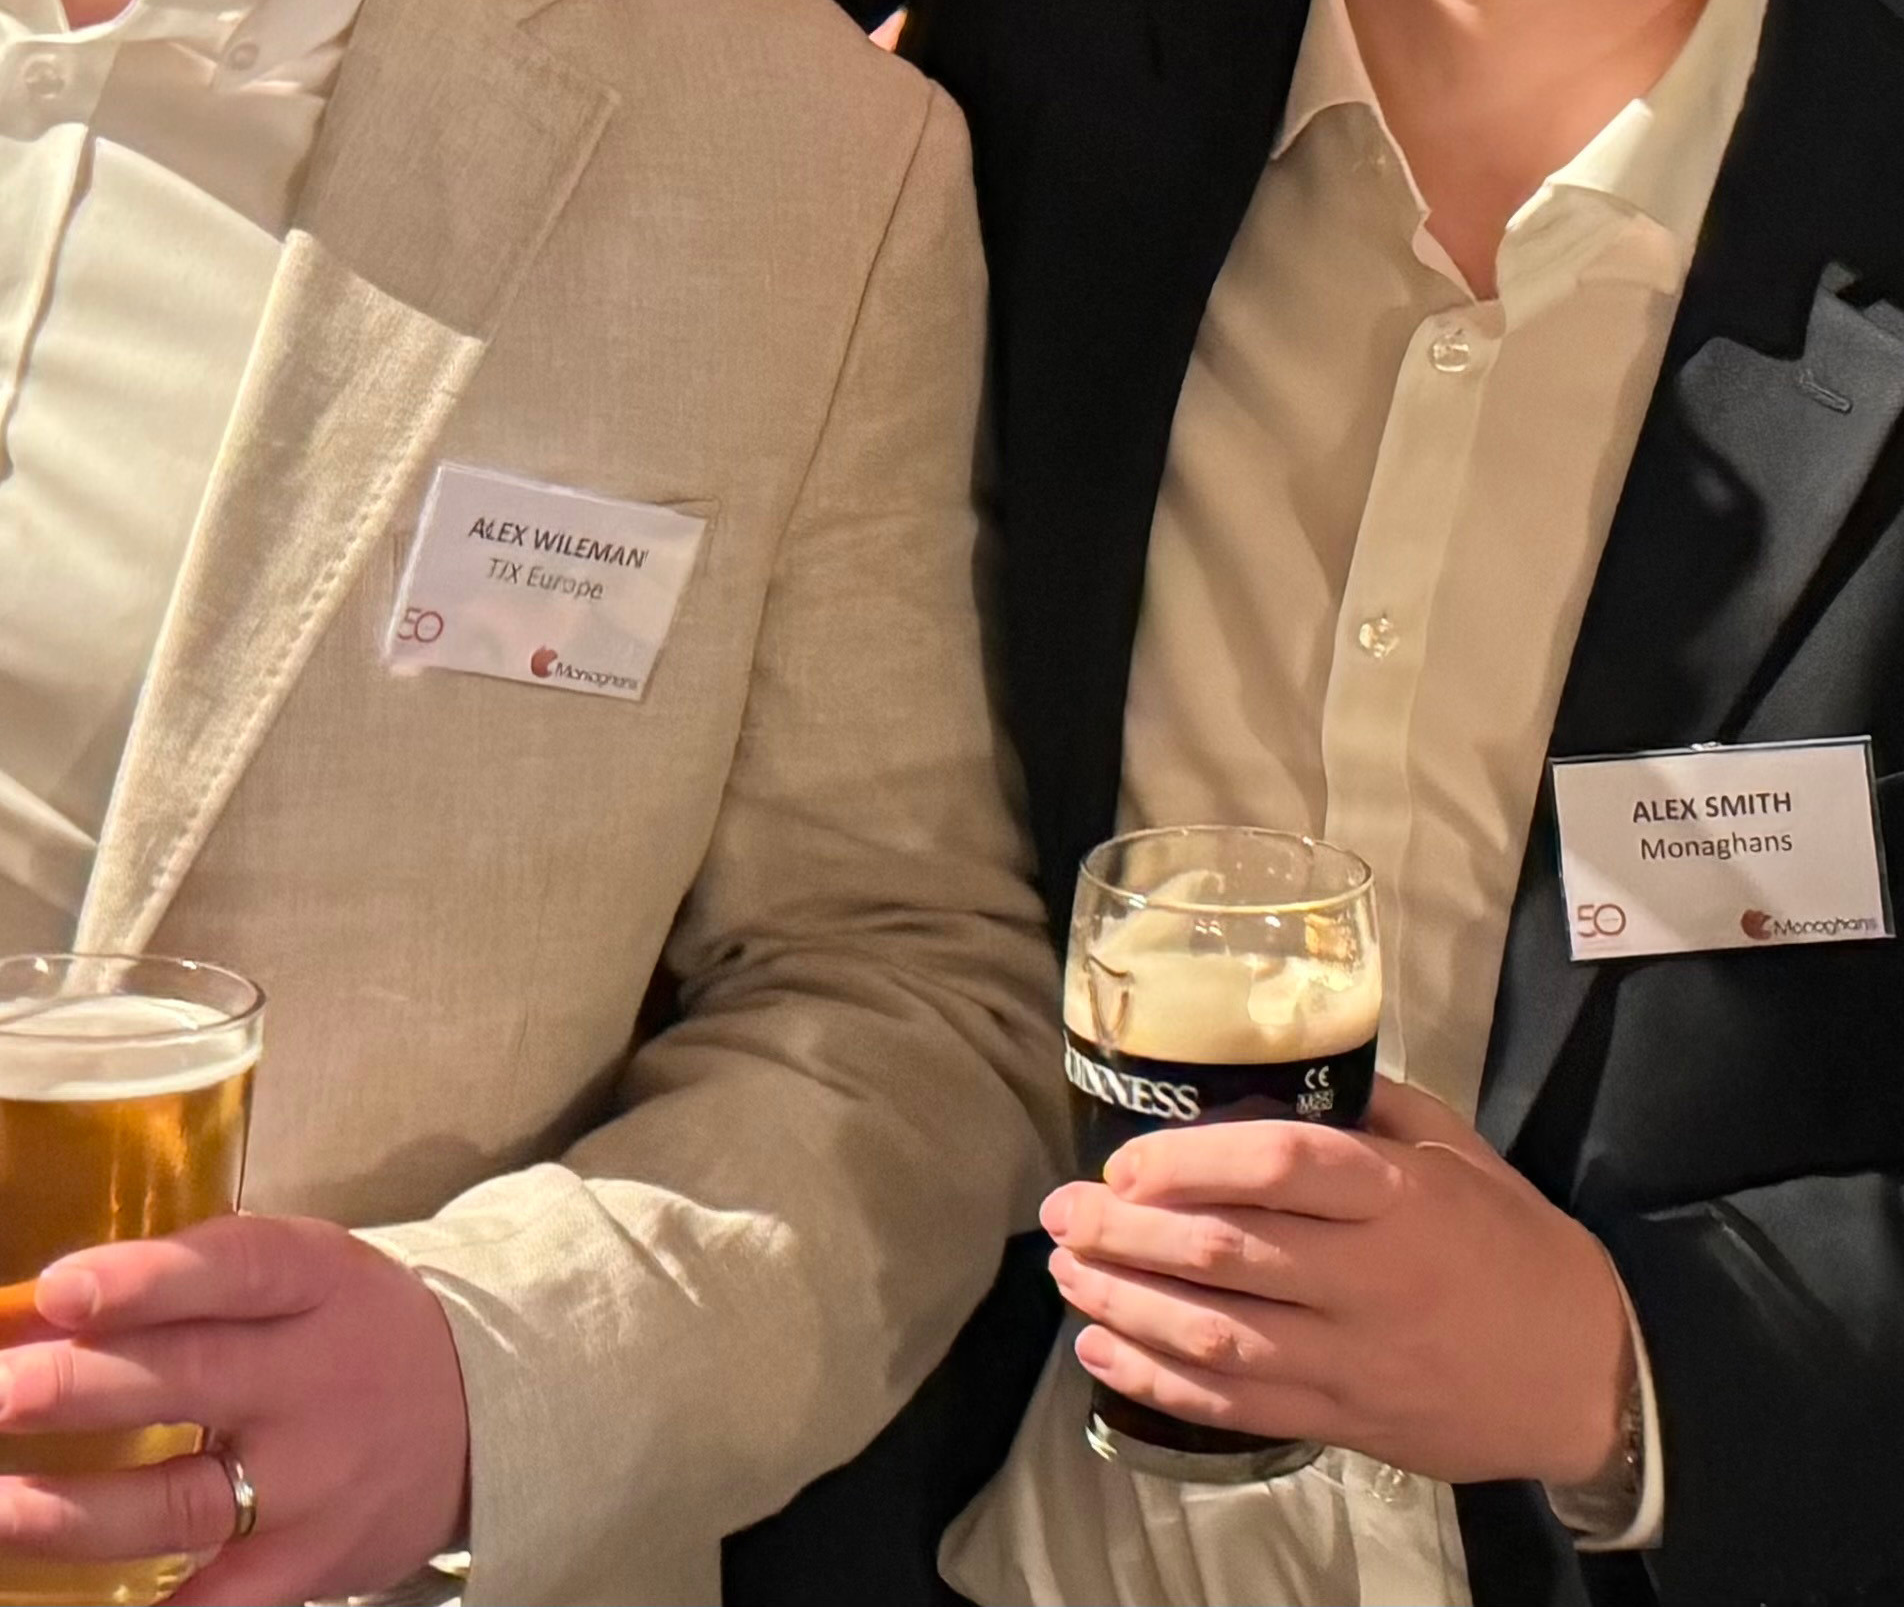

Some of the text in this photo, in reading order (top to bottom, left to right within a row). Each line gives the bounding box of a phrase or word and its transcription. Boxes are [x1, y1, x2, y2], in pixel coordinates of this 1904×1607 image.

[468, 516, 649, 569] ALEX WILEMAN
[526, 565, 604, 600] Europe
[1632, 791, 1792, 823] ALEX SMITH
[1640, 831, 1793, 860] Monaghans
[1577, 903, 1627, 938] 50
